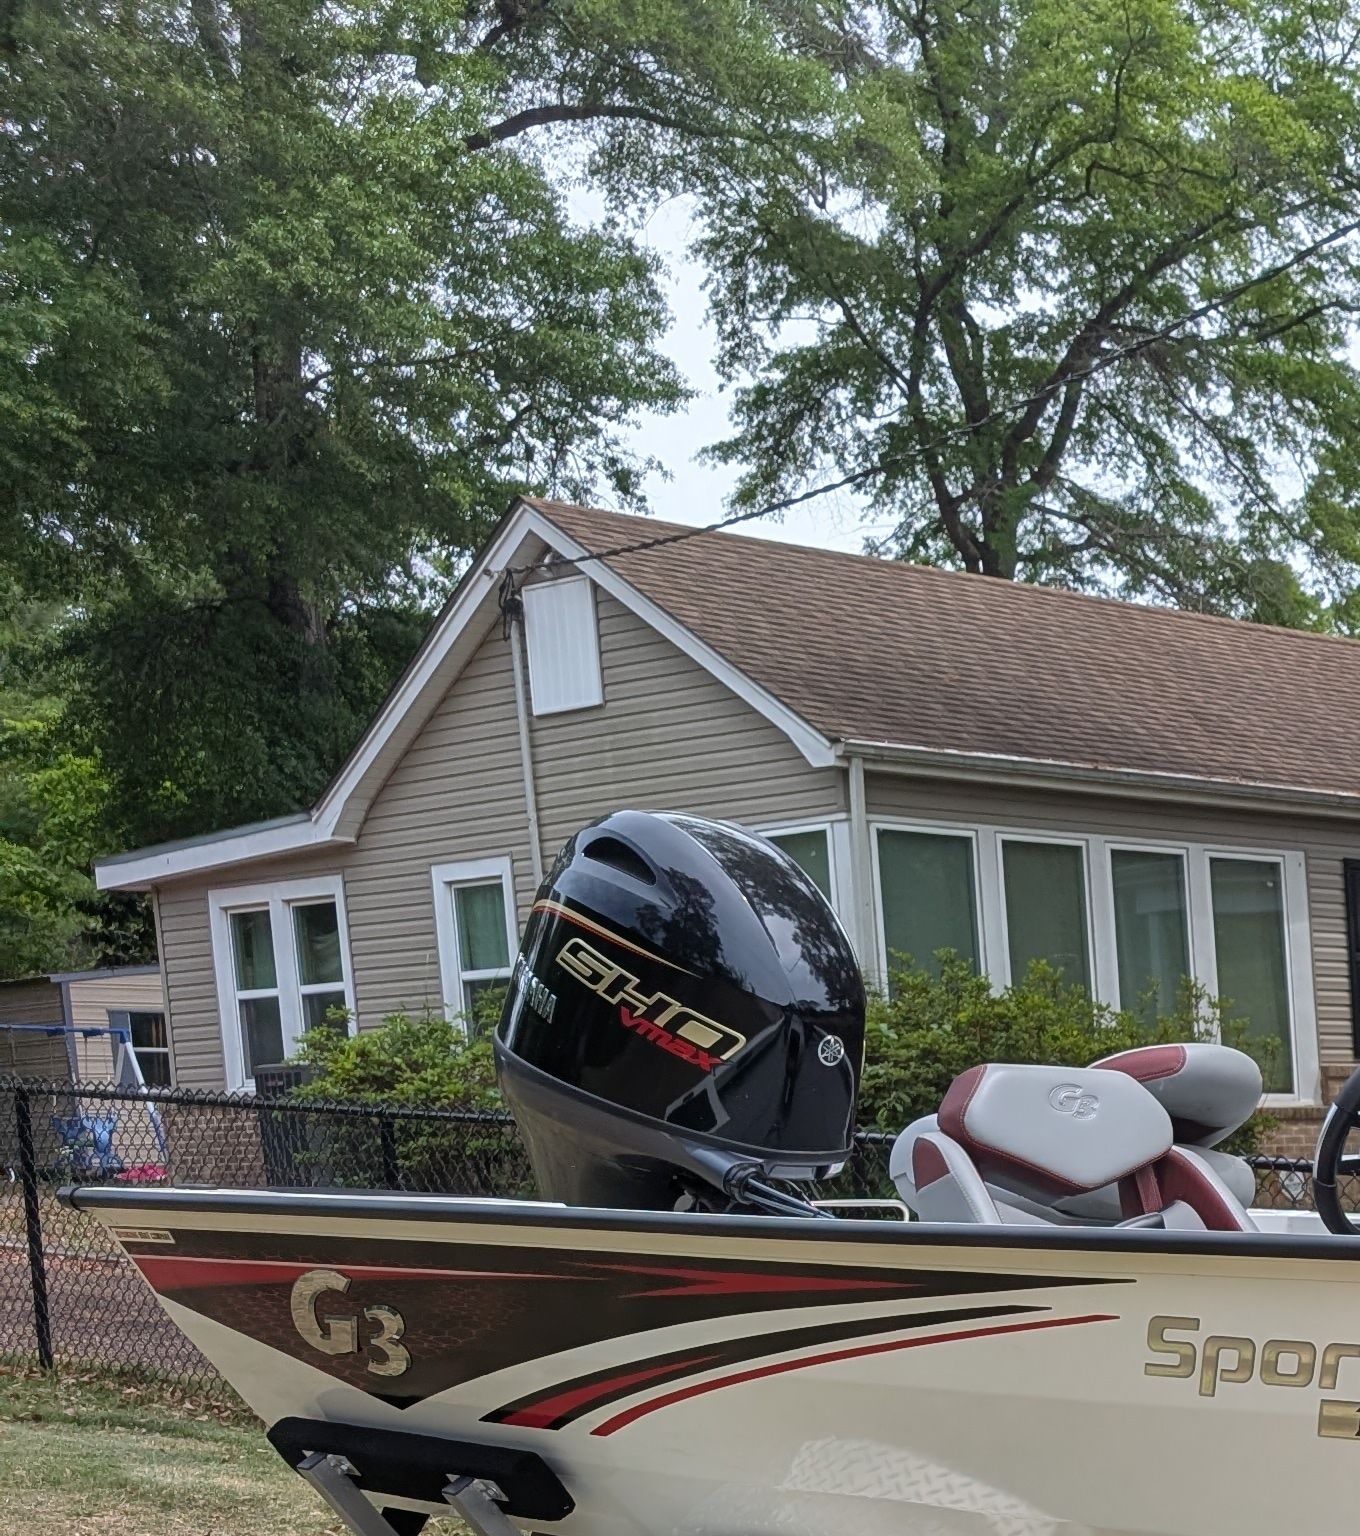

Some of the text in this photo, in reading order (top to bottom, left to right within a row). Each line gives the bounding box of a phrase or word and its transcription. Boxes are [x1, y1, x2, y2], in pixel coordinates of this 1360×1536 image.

[556, 937, 747, 1061] SHO
[1049, 1083, 1099, 1120] G3
[291, 1270, 412, 1376] G3
